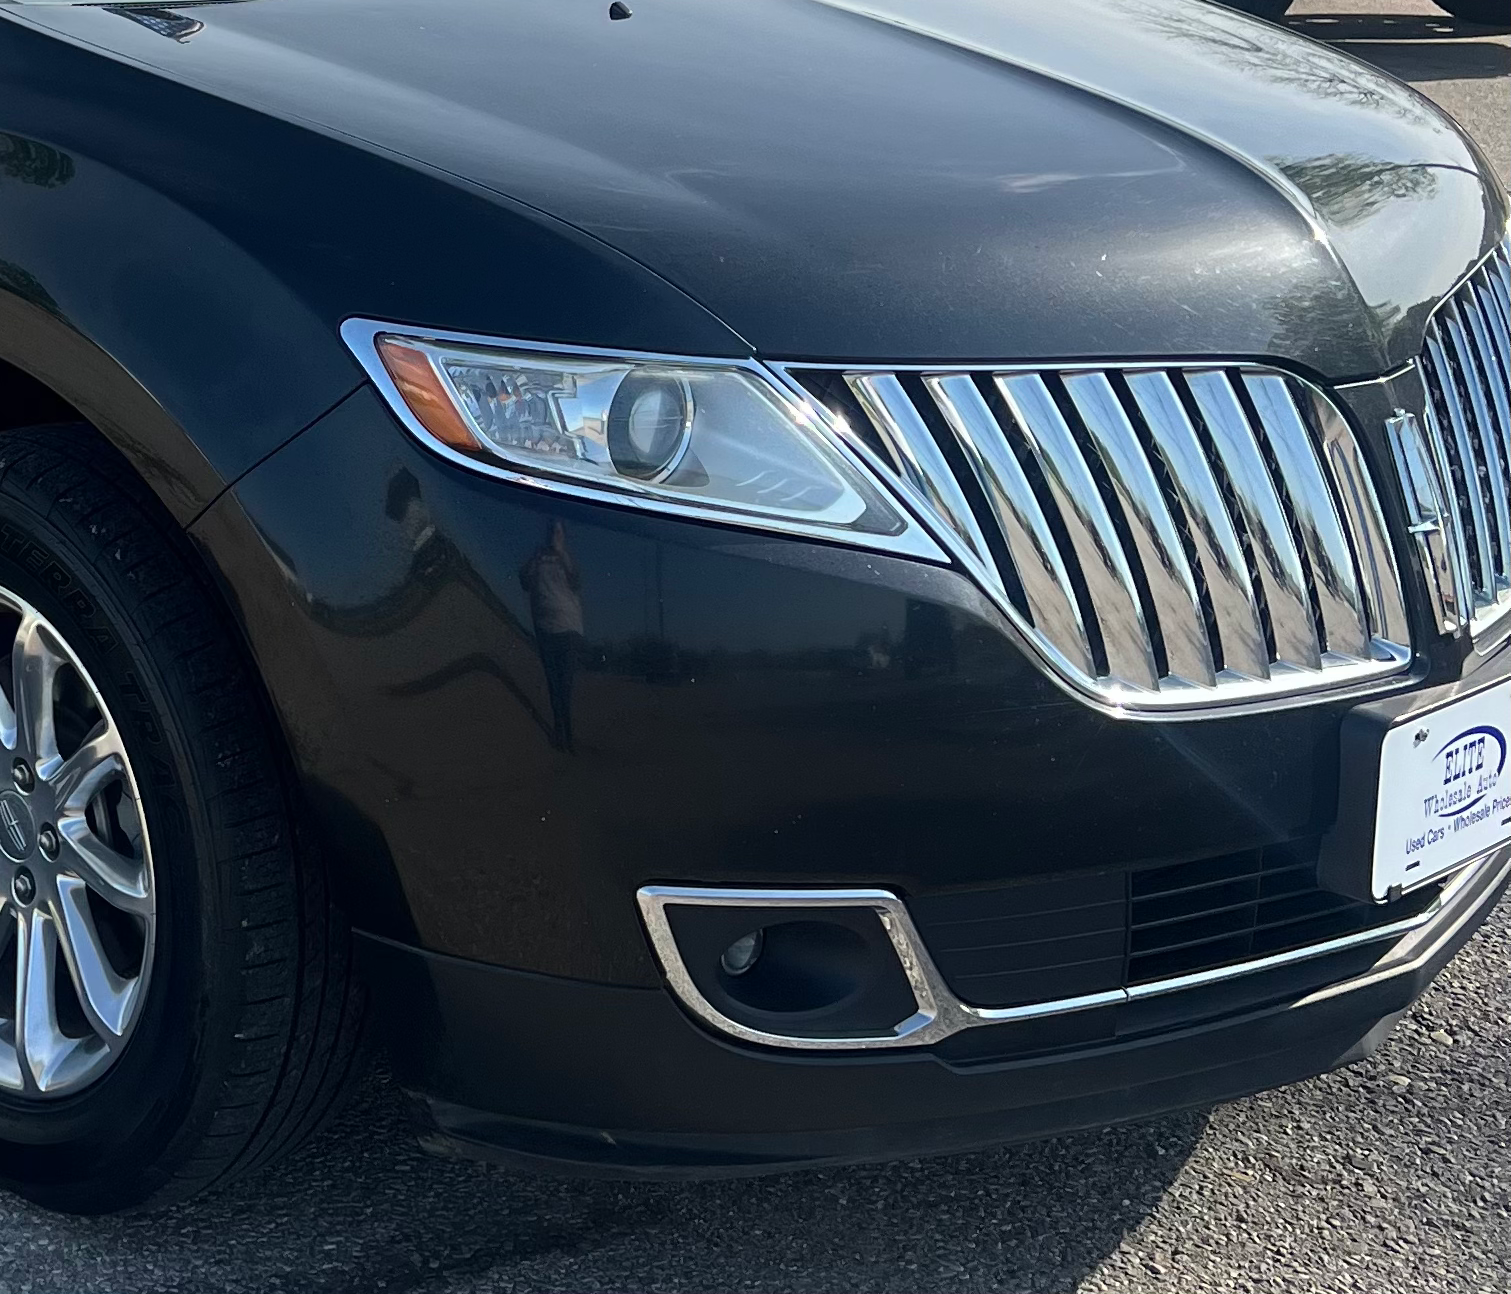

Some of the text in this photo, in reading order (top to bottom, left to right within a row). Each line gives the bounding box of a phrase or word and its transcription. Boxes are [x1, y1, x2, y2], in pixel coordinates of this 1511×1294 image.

[0, 523, 119, 659] TERRA
[1443, 736, 1486, 785] ELITE
[1424, 770, 1498, 818] Wholesale Auto
[1406, 796, 1511, 854] Used Cars Wholesale Price
